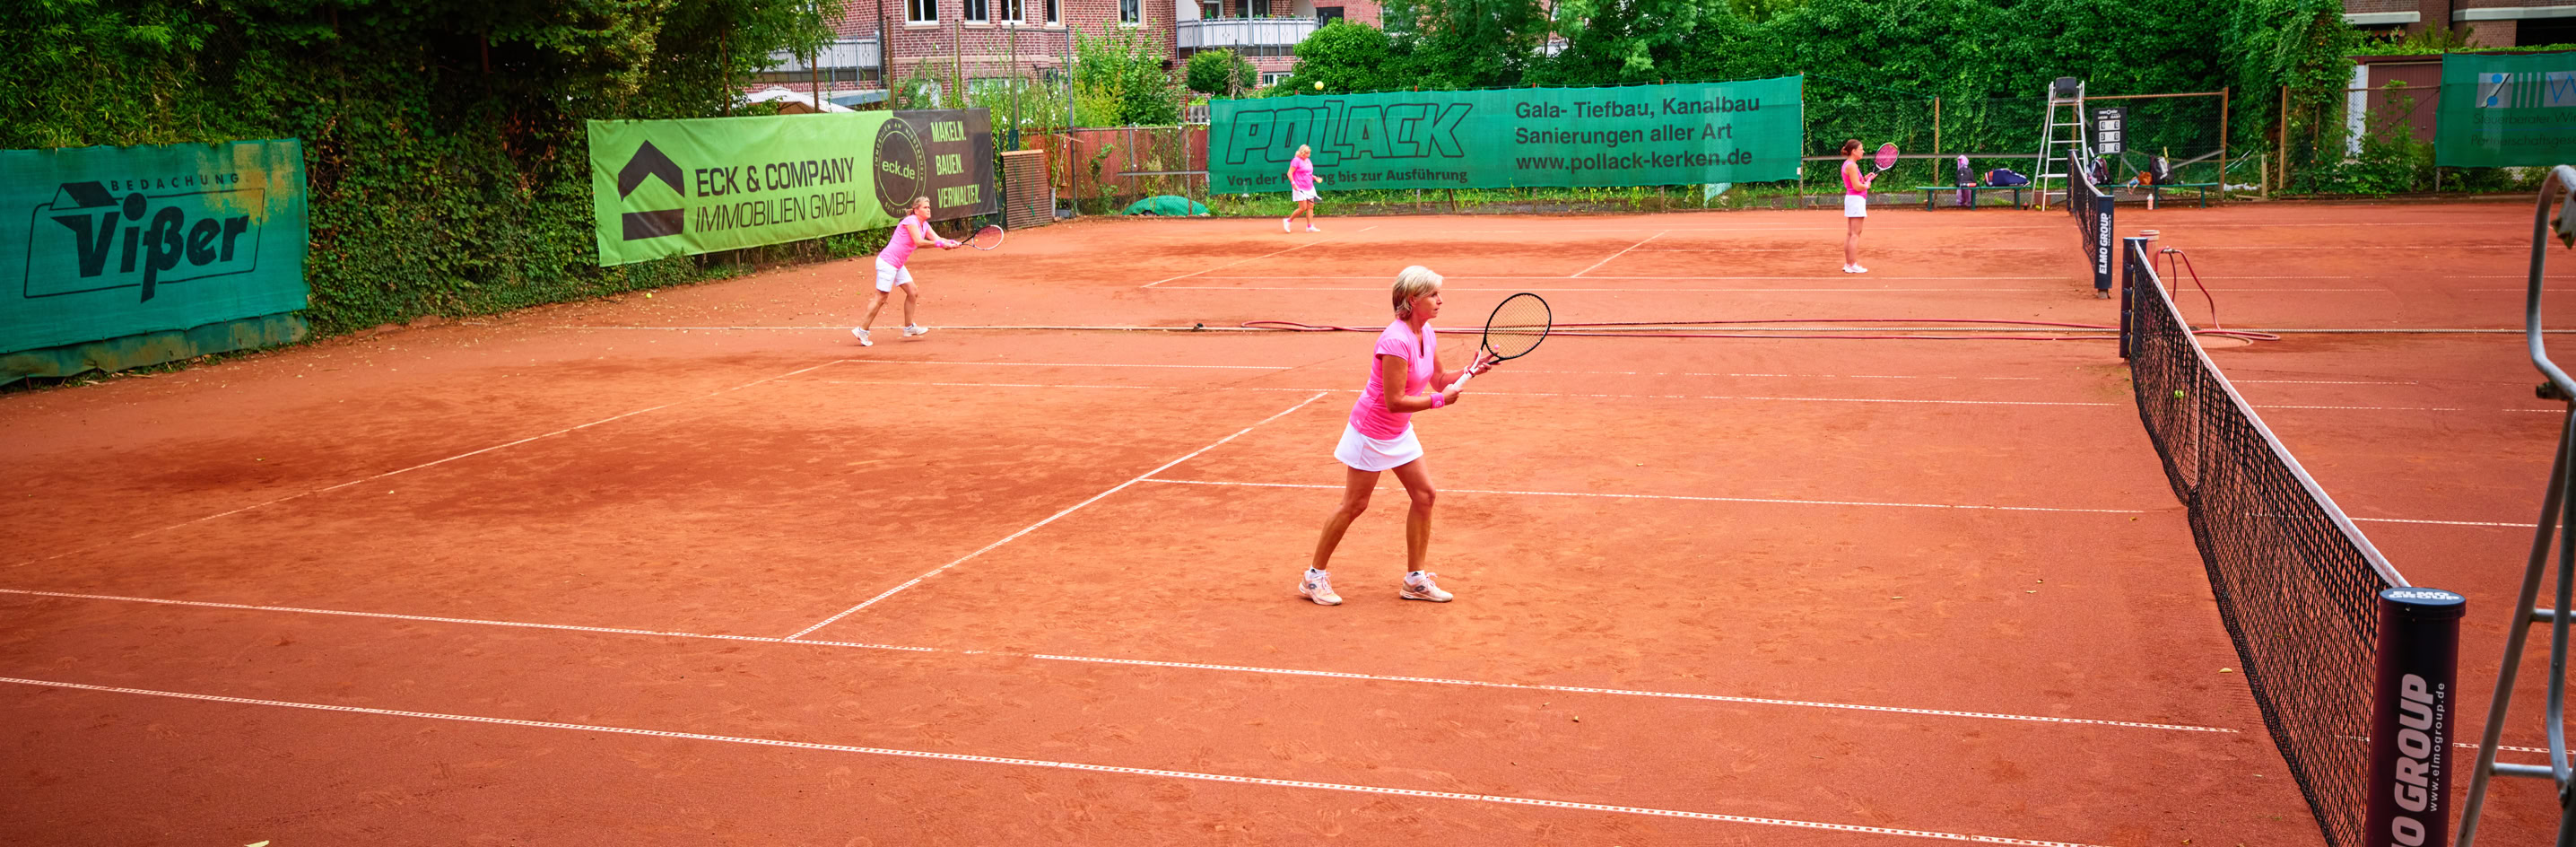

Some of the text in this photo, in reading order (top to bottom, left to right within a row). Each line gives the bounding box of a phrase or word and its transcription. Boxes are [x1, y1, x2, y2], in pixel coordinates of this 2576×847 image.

[1516, 96, 1760, 119] Gala- Tiefbau, Kanalbau
[930, 120, 966, 143] MAKELN.
[1225, 100, 1473, 167] POLLACK
[1515, 122, 1733, 148] Sanierungen aller Art
[882, 160, 915, 180] eck.de
[936, 153, 964, 176] BAUEN.
[1516, 148, 1753, 174] www.pollack-kerken.de
[111, 173, 239, 191] BEDACHUNG
[695, 157, 854, 197] ECK & COMPANY
[1227, 175, 1252, 186] Von
[1257, 173, 1277, 185] der
[1338, 170, 1357, 182] bis
[1361, 171, 1383, 182] zur
[1387, 169, 1468, 184] Ausführung
[937, 183, 981, 209] VERWALTEN.
[695, 190, 856, 233] IMMOBILIEN GMBH
[50, 192, 249, 304] Vißer
[2099, 213, 2109, 275] ELMO GROUP
[2394, 673, 2433, 813] GROUP
[2430, 683, 2445, 812] www.elmogroup.de
